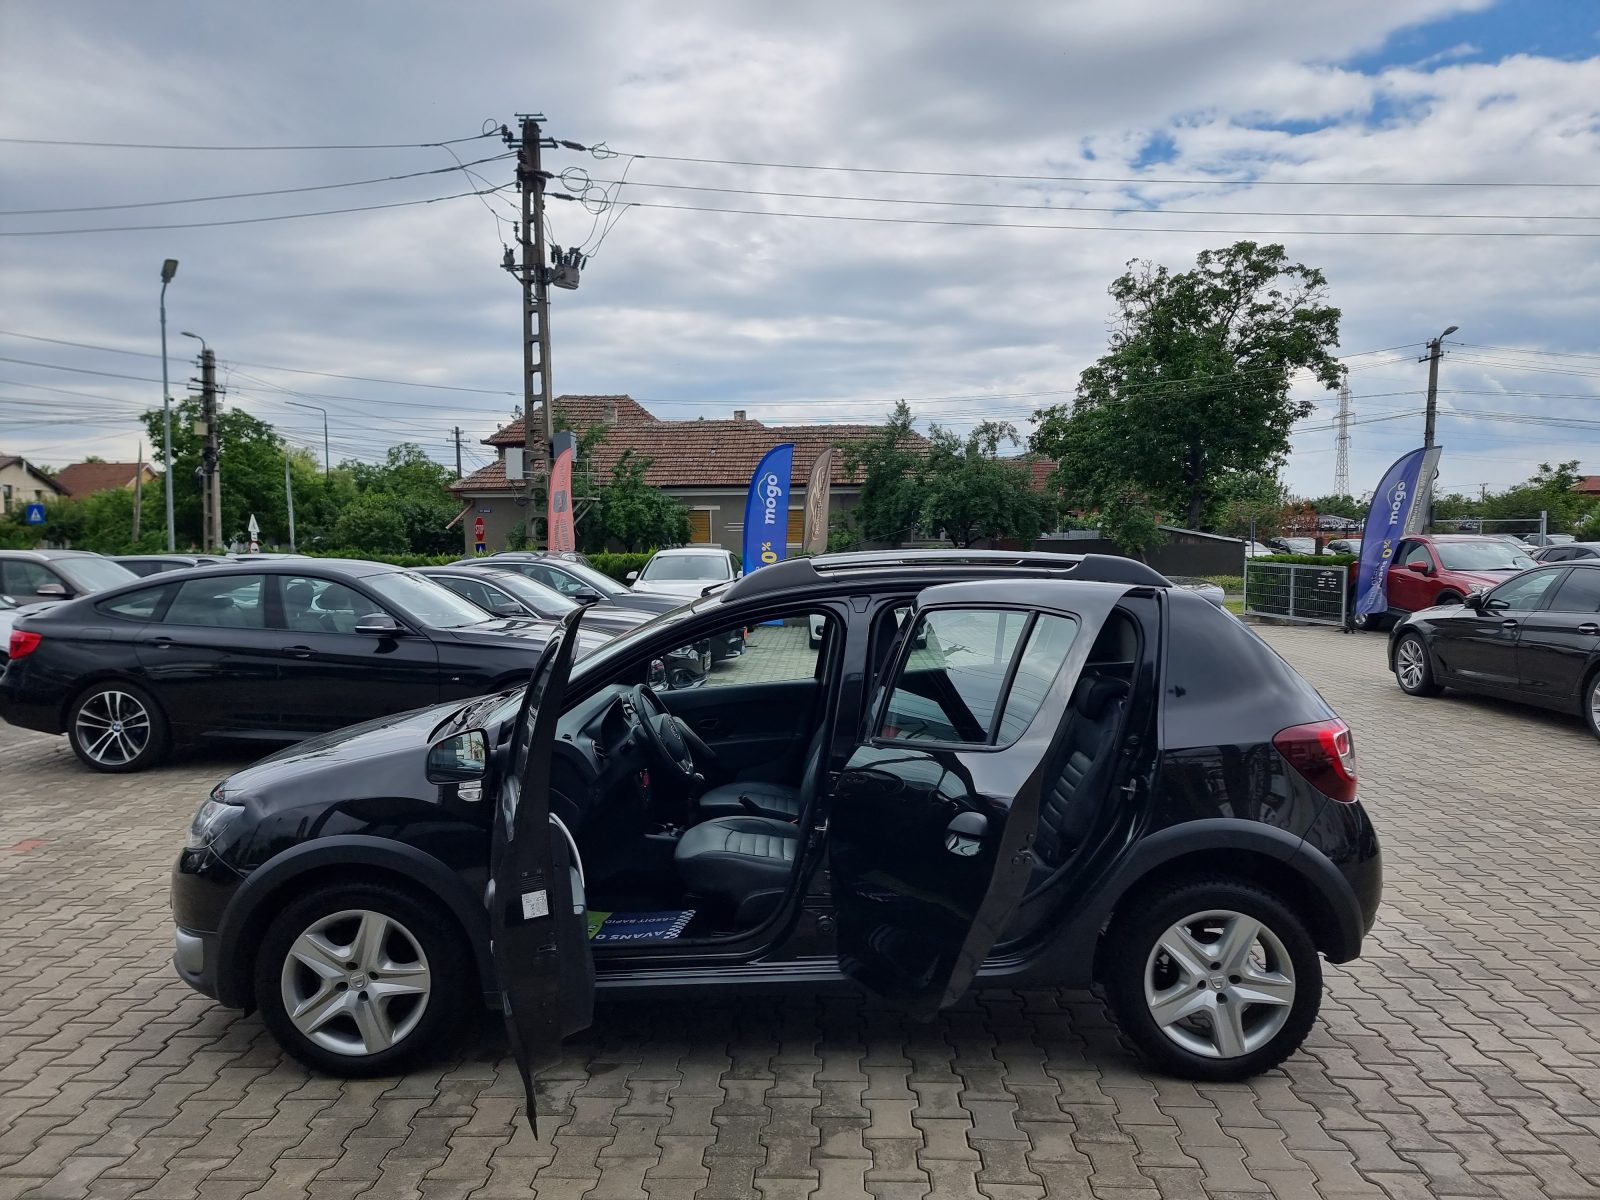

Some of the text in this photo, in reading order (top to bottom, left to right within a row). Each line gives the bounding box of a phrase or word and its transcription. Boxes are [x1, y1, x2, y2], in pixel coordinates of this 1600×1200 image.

[765, 474, 782, 524] mogo
[1388, 481, 1407, 525] mogo
[761, 541, 778, 563] 0%
[1381, 539, 1393, 558] 0%
[609, 930, 665, 940] AVANS
